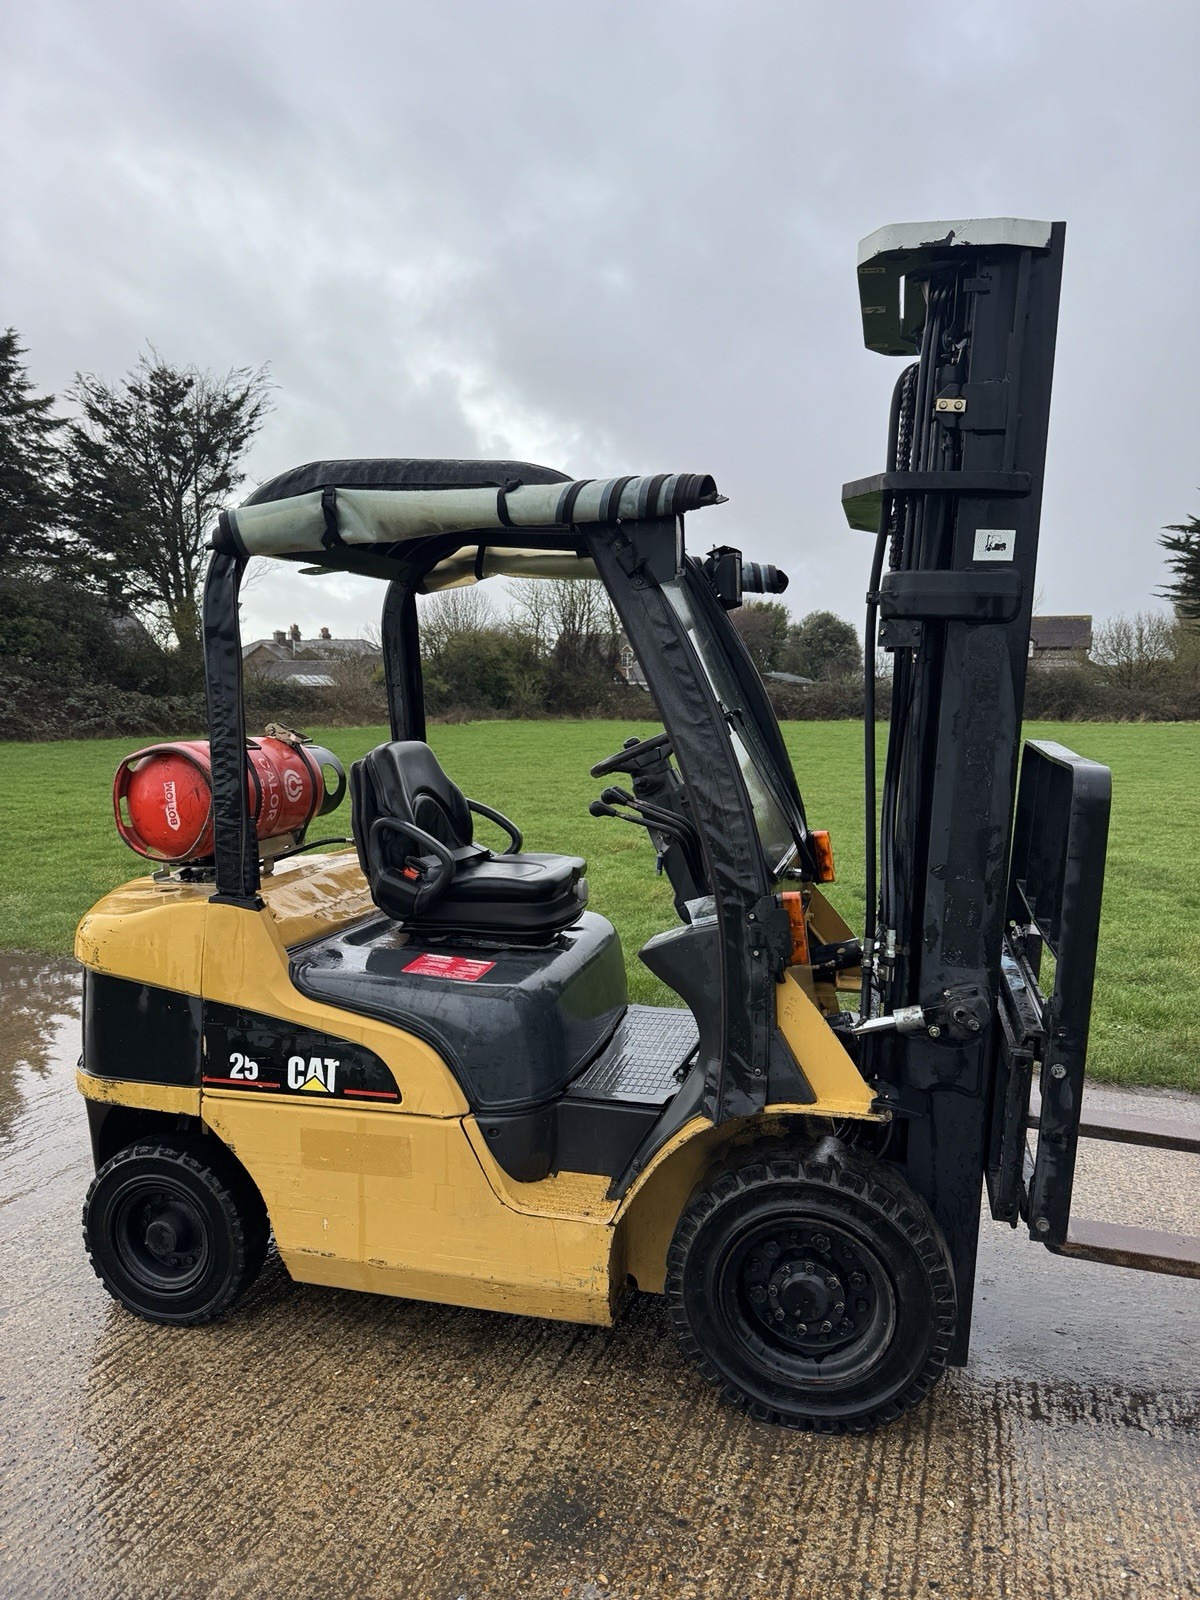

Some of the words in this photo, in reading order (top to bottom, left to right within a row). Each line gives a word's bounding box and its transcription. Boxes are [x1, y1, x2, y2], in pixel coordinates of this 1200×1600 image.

[165, 782, 179, 826] BOTTOM
[258, 757, 279, 821] CALOR
[229, 1052, 259, 1080] 25
[287, 1055, 340, 1093] CAT
